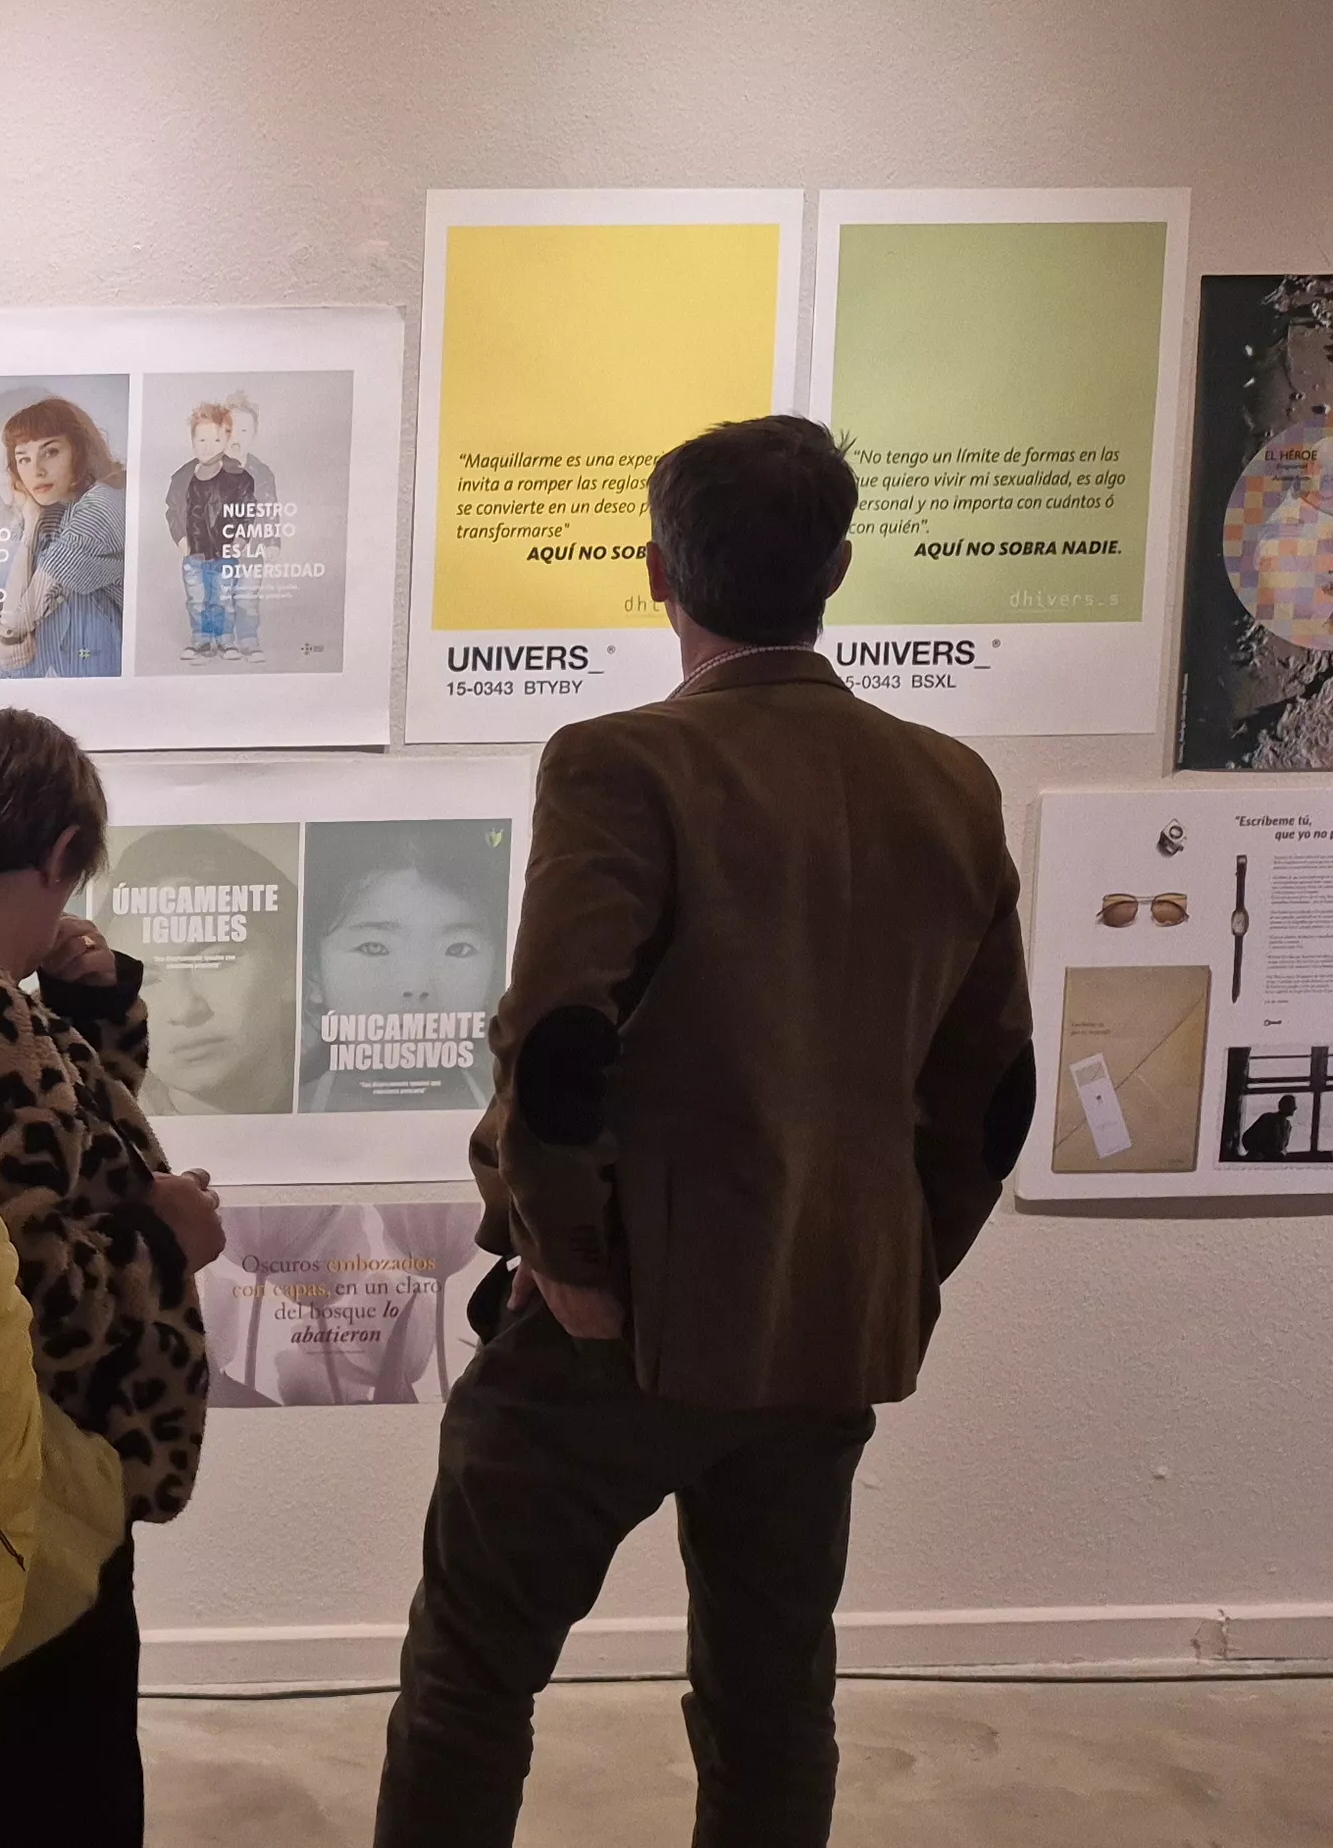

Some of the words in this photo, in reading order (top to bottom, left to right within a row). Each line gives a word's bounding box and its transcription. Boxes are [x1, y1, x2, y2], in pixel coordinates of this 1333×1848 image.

[566, 455, 581, 468] es
[585, 454, 614, 467] una
[886, 449, 928, 468] tengo
[933, 452, 952, 464] un
[956, 448, 1000, 464] límite
[1003, 447, 1021, 463] de
[1022, 446, 1075, 467] formas
[1079, 450, 1096, 462] en
[1100, 446, 1120, 462] las
[1265, 450, 1276, 460] EL
[1280, 449, 1318, 460] HÉROE
[458, 477, 499, 492] invita
[504, 480, 514, 491] a
[517, 477, 574, 495] romper
[576, 475, 598, 490] las
[854, 475, 879, 489] ue
[882, 472, 930, 491] quiero
[934, 472, 966, 487] vivir
[969, 471, 989, 487] mi
[993, 470, 1072, 489] sexualidad,
[1076, 474, 1091, 486] es
[1094, 469, 1126, 490] algo
[223, 503, 298, 518] NUESTRO
[456, 504, 473, 516] se
[476, 500, 545, 516] convierte
[548, 503, 566, 515] en
[571, 502, 590, 514] un
[594, 499, 636, 514] deseo
[858, 494, 913, 511] ersonal
[914, 498, 927, 515] y
[930, 498, 949, 510] no
[953, 495, 1012, 513] importa
[1016, 497, 1042, 510] con
[1045, 494, 1102, 509] cuántos
[1104, 494, 1115, 508] ó
[222, 523, 296, 538] CAMBIO
[848, 523, 875, 535] con
[222, 544, 241, 559] ES
[246, 544, 266, 558] LA
[526, 542, 578, 565] AQUÍ
[579, 546, 607, 561] NO
[610, 545, 647, 560] SOB
[914, 539, 965, 561] AQUÍ
[966, 542, 996, 556] NO
[998, 541, 1057, 556] SOBRA
[1061, 540, 1122, 555] NADIE.
[222, 563, 325, 579] DIVERSIDAD
[446, 681, 514, 696] 15-0343
[524, 680, 583, 695] BTYBY
[844, 675, 901, 690] 5-0343
[911, 674, 957, 689] BSXL
[1298, 814, 1312, 827] tú,
[1274, 830, 1295, 842] que
[1298, 830, 1311, 842] yo
[1313, 830, 1327, 839] no
[112, 882, 279, 915] ÚNICAMENTE
[142, 914, 247, 944] IGUALES
[321, 1009, 486, 1043] ÚNICAMENTE
[329, 1041, 474, 1071] INCLUSIVOS
[242, 1255, 320, 1273] Oscuros
[326, 1252, 436, 1273] embozados
[232, 1284, 266, 1298] con
[272, 1283, 331, 1300] capas,
[335, 1282, 358, 1296] en
[365, 1281, 388, 1295] un
[395, 1276, 442, 1294] claro
[274, 1302, 302, 1320] del
[310, 1301, 377, 1325] bosque
[382, 1300, 400, 1319] lo
[291, 1326, 382, 1345] abatieron
